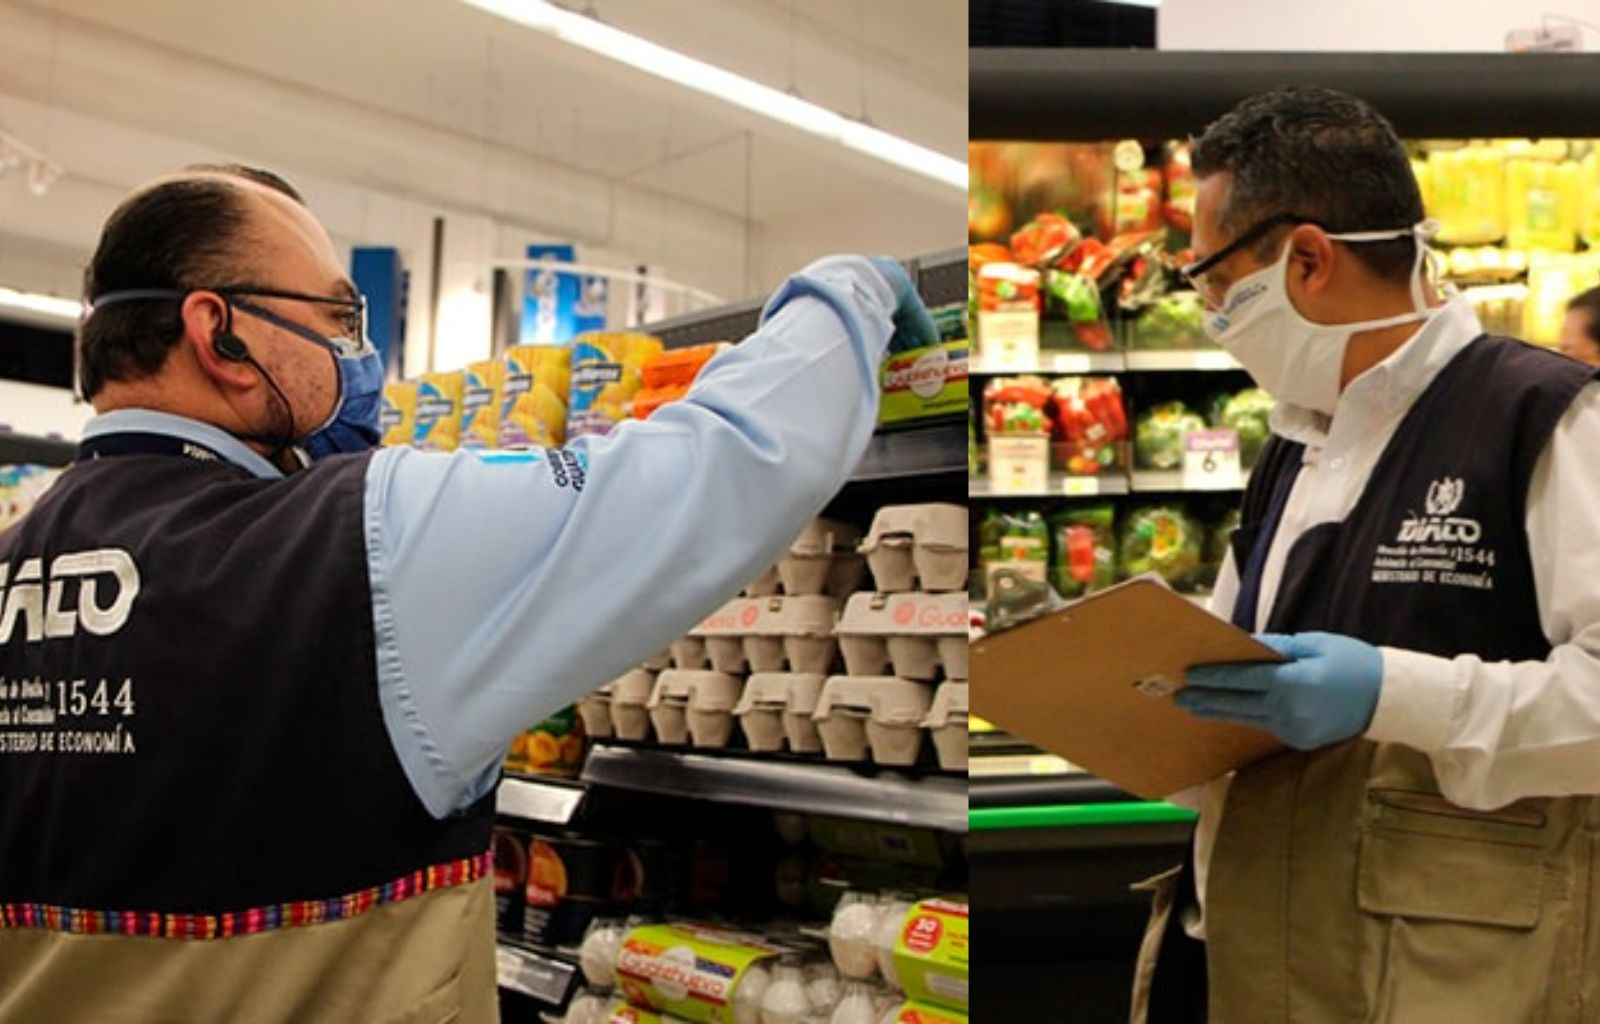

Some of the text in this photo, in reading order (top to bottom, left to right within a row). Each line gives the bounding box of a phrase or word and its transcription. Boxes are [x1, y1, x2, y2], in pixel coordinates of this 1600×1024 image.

[1202, 451, 1218, 474] 6
[1457, 546, 1495, 567] 1544
[56, 678, 136, 716] 1544
[40, 731, 54, 752] DE
[58, 722, 136, 754] ECONOMÍA
